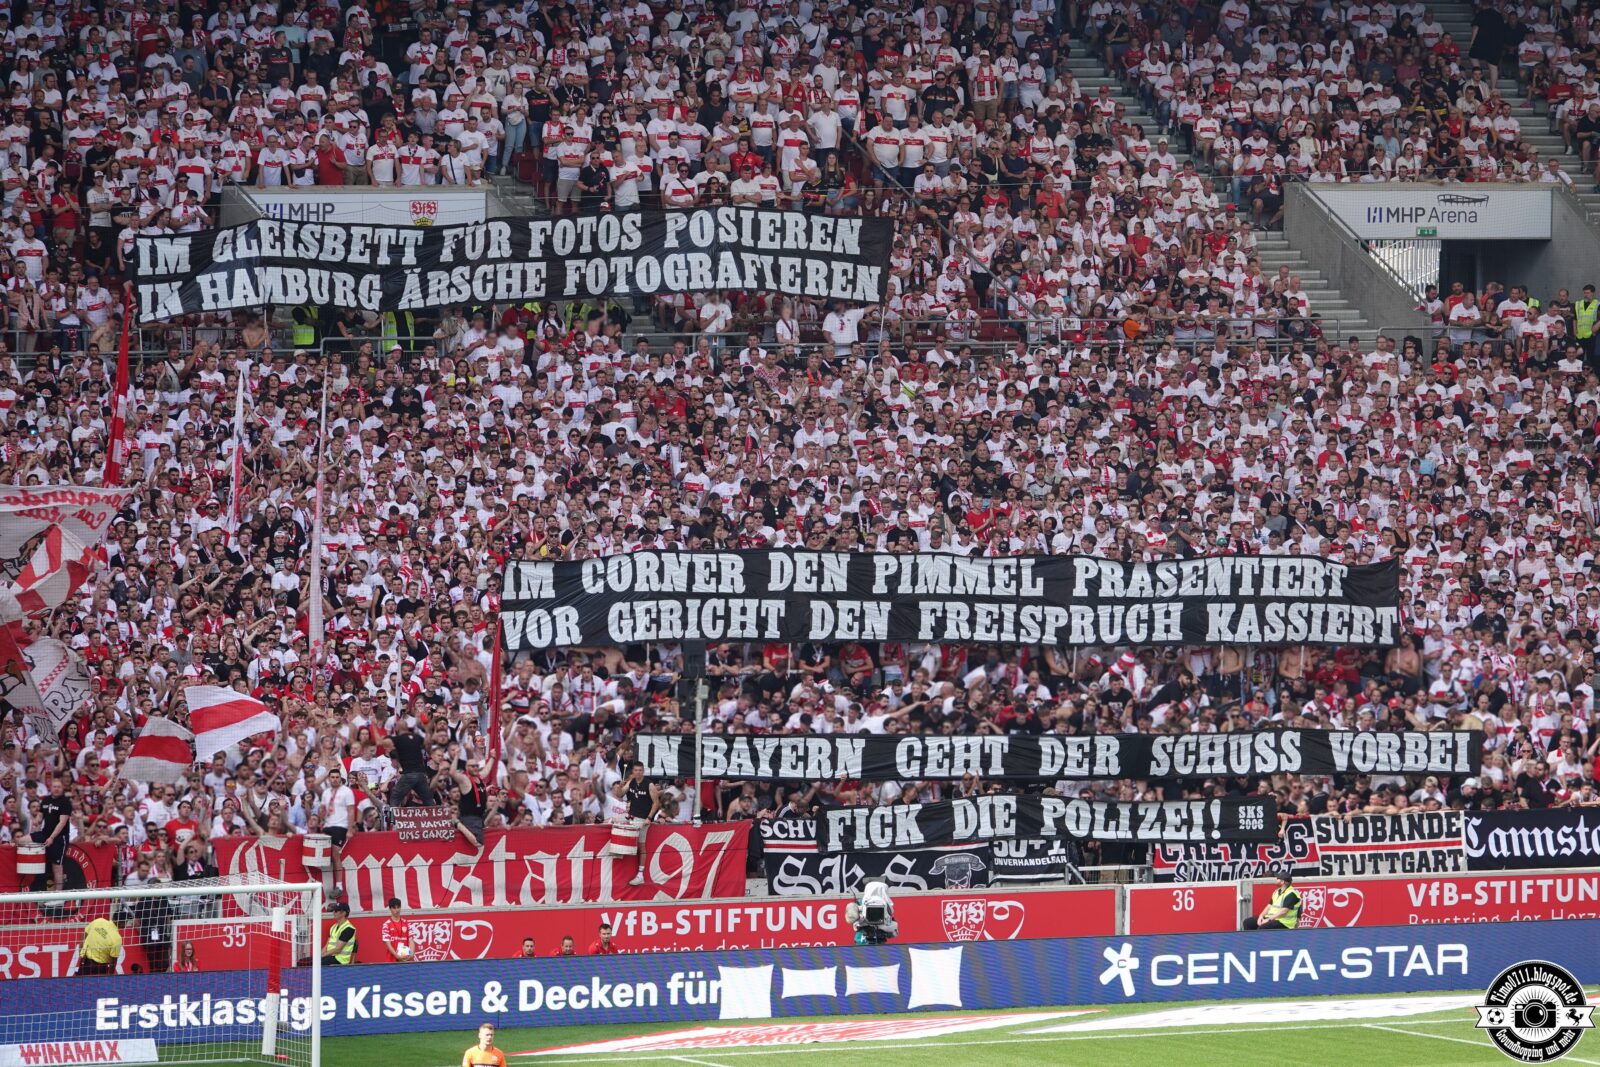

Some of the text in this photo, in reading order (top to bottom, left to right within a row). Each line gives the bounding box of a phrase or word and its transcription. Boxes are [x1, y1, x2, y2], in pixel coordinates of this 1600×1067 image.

[288, 203, 335, 221] MHP
[1386, 207, 1477, 223] MHP Arena
[136, 207, 862, 275] IM GLEISBETT FÜR FOTOS POSIEREN
[137, 251, 881, 323] IN HAMBURG ÄRSCHE FOTOGRAFIEREN
[501, 561, 555, 600] IM
[581, 552, 745, 594] CORNER
[767, 552, 850, 593] DEN
[872, 554, 1044, 596] PIMMEL
[499, 598, 1397, 650] VOR GERICHT DEN FREISPRUCH KASSIERT
[637, 732, 1470, 778] IN BAYERN GEHT DER SCHUSS VORBEI
[393, 808, 428, 817] ULTRA
[396, 820, 416, 829] DER
[827, 796, 1221, 851] FICK DIE POLIZEI!
[1239, 805, 1264, 818] SKS
[1239, 818, 1264, 830] 2006
[399, 829, 455, 840] UMS GANZE
[649, 830, 735, 900] 97
[994, 856, 1067, 867] UNVERHANDELBAR
[1321, 848, 1464, 876] STUTTGART
[1172, 889, 1194, 911] 36
[1407, 877, 1598, 907] VfB-STIFTUN
[601, 904, 837, 937] VfB-STIFTUNG
[222, 925, 246, 948] 35
[1150, 943, 1469, 986] CENTA-STAR
[346, 985, 471, 1020] Kissen
[480, 981, 509, 1014] &
[519, 976, 657, 1012] Decken
[668, 971, 722, 1005] für
[19, 1041, 122, 1065] WINAMAX
